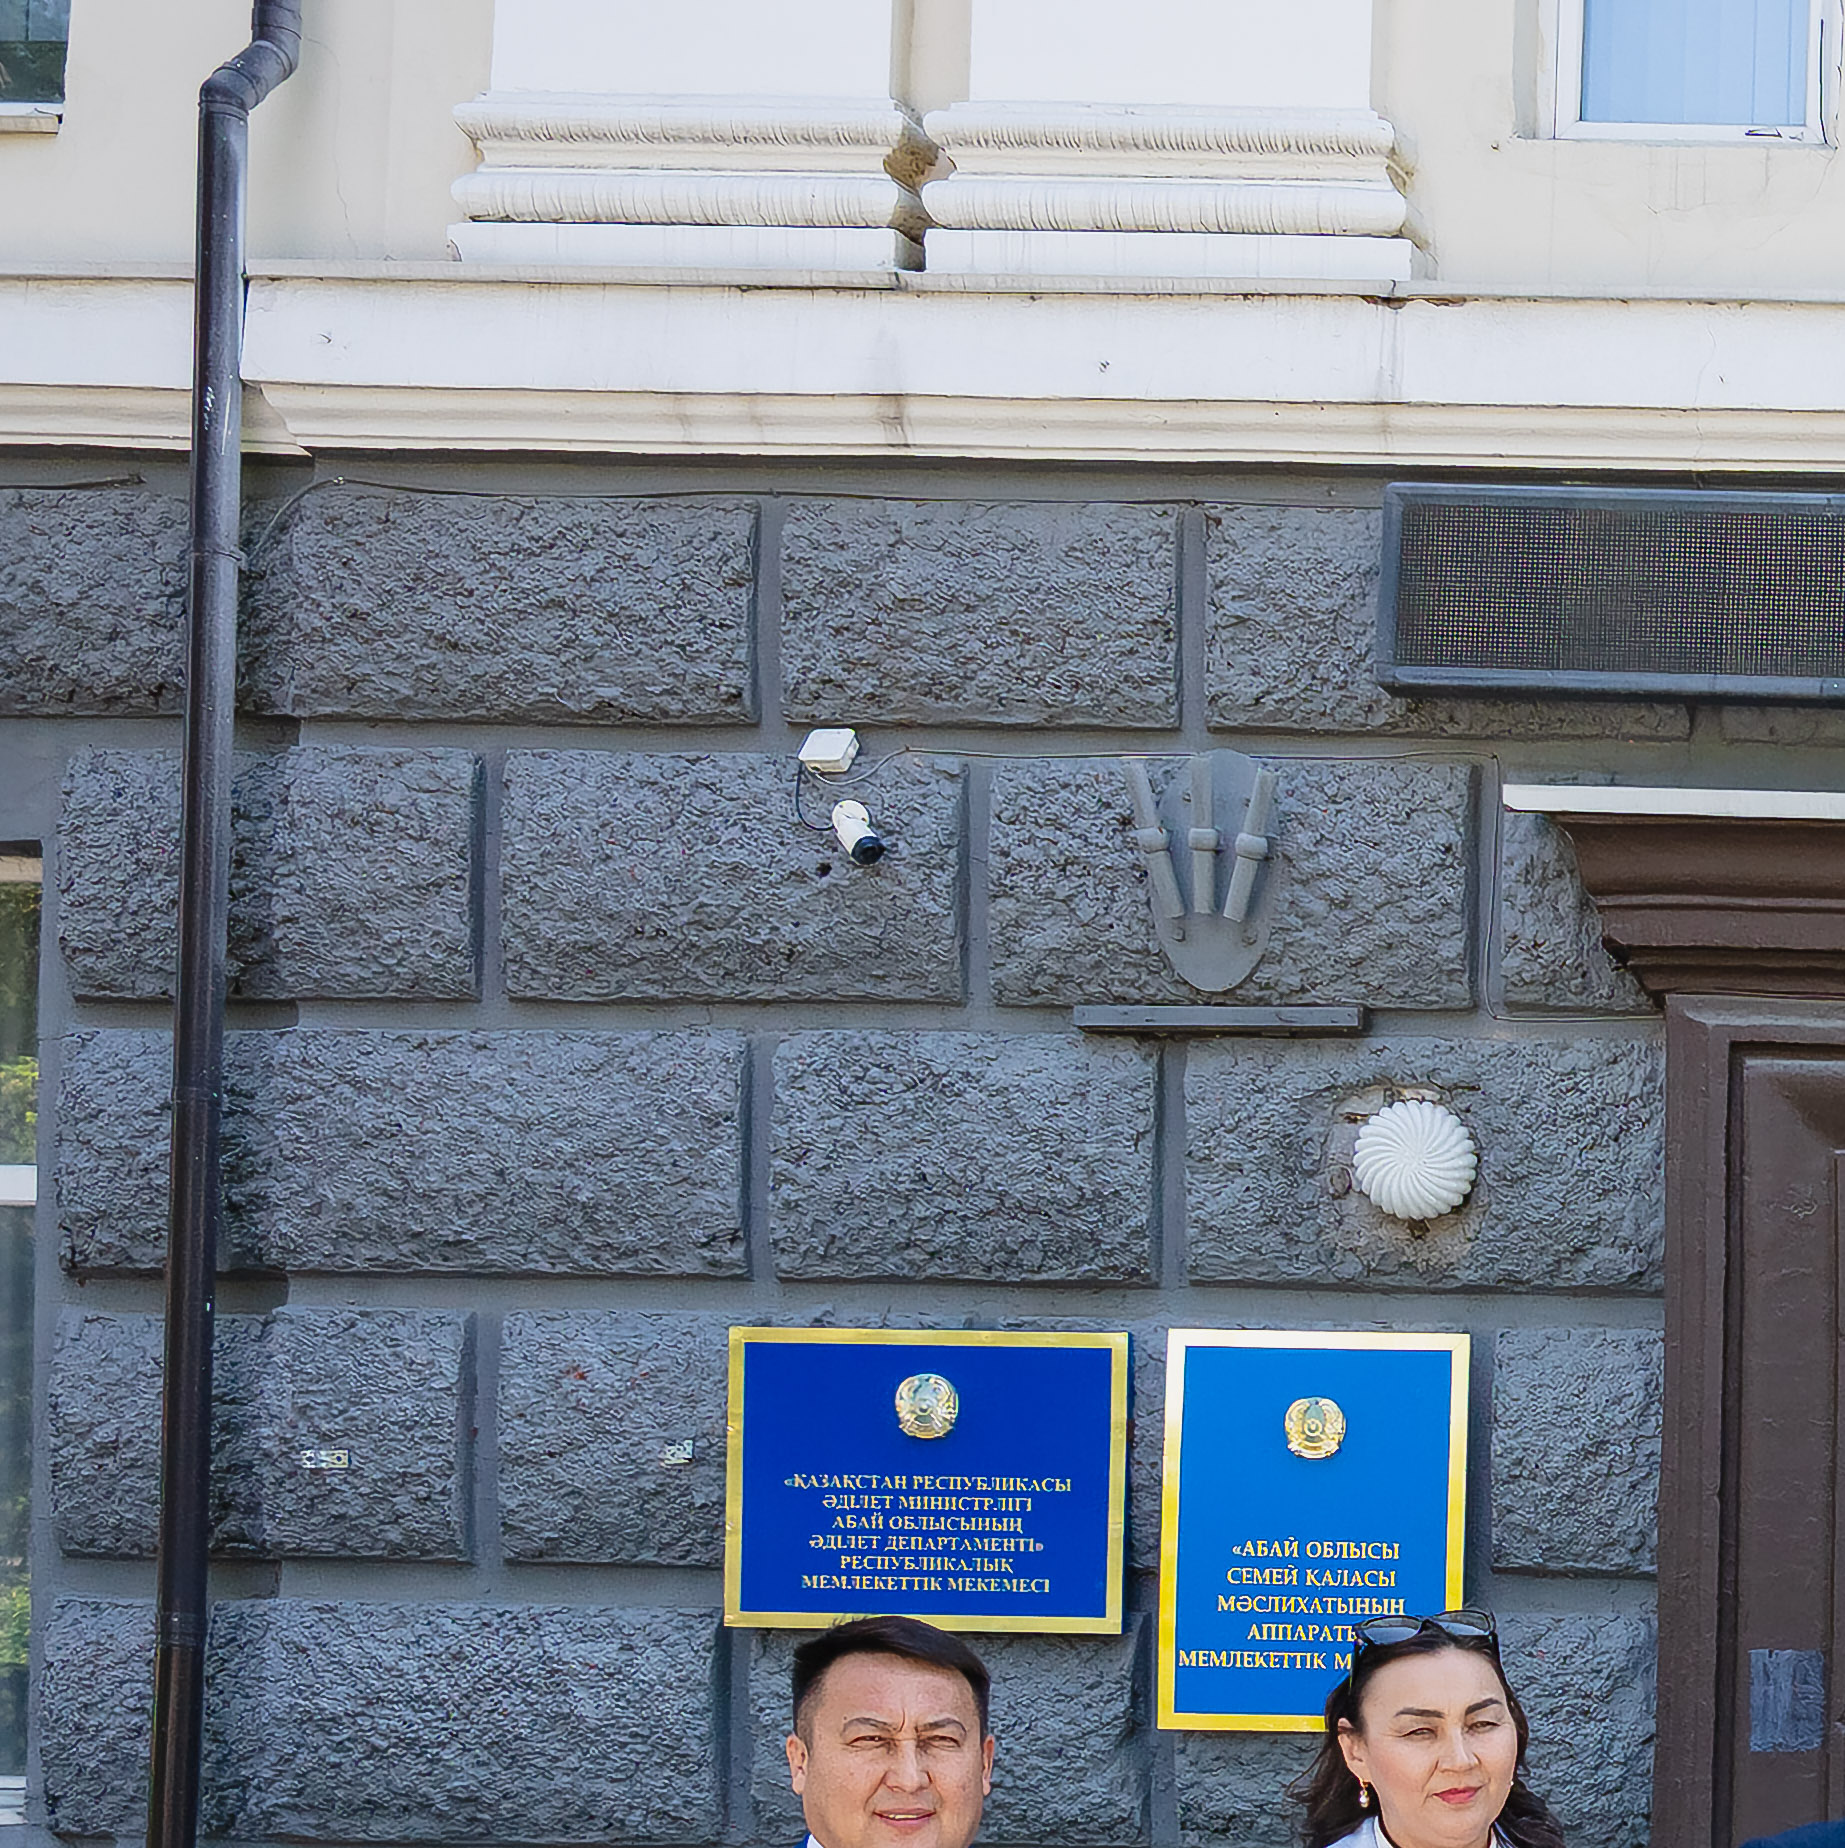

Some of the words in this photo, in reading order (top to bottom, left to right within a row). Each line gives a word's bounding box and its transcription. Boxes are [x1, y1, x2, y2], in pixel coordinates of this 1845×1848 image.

[913, 1475, 1072, 1492] РЕСПУБЛИКАСЫ
[832, 1512, 884, 1529] АБАЙ
[889, 1516, 1023, 1534] ОБЛЫСЫНЫҢ
[1232, 1537, 1299, 1558] «АБАЙ
[1306, 1541, 1400, 1560] ОБЛЫСЫ
[840, 1556, 1014, 1574] РЕСПУБЛИКАЛЫҚ
[801, 1575, 942, 1591] МЕМЛЕКЕТТІК
[947, 1577, 1050, 1593] МЕКЕМЕСІ
[1226, 1565, 1298, 1586] СЕМЕЙ
[1305, 1569, 1396, 1590] ҚАЛАСЫ
[1178, 1650, 1326, 1669] МЕМЛЕКЕТТІК
